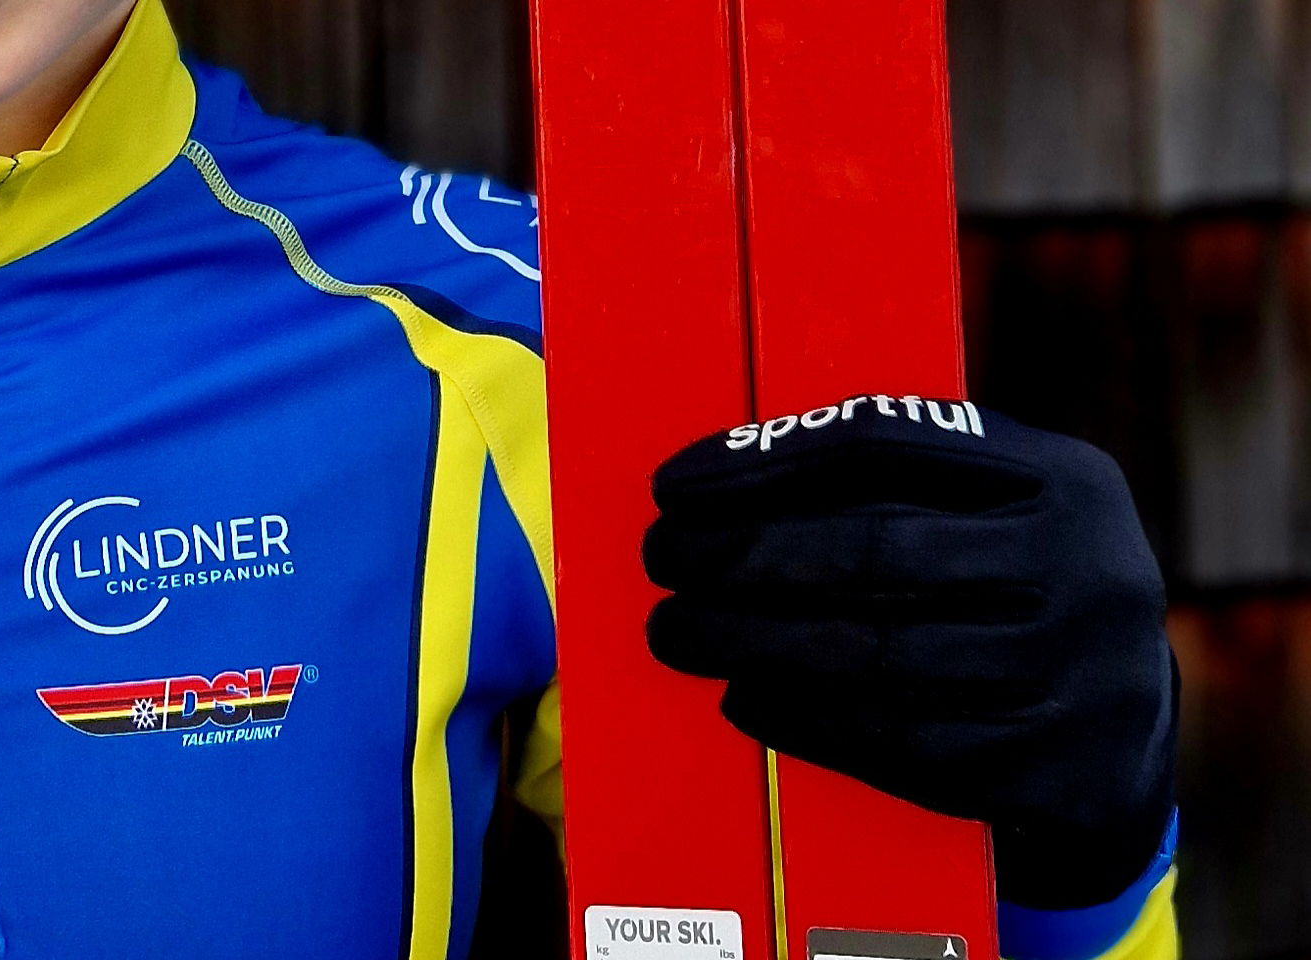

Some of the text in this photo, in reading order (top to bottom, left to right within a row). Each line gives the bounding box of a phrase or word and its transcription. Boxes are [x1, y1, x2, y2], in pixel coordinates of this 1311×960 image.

[726, 394, 986, 452] sportful
[73, 514, 291, 578] LINDNER
[106, 561, 296, 595] CNC-ZERSPANUNG
[168, 664, 303, 730] DSV
[596, 944, 736, 959] kg lbs
[605, 917, 722, 946] YOUR SKI.
